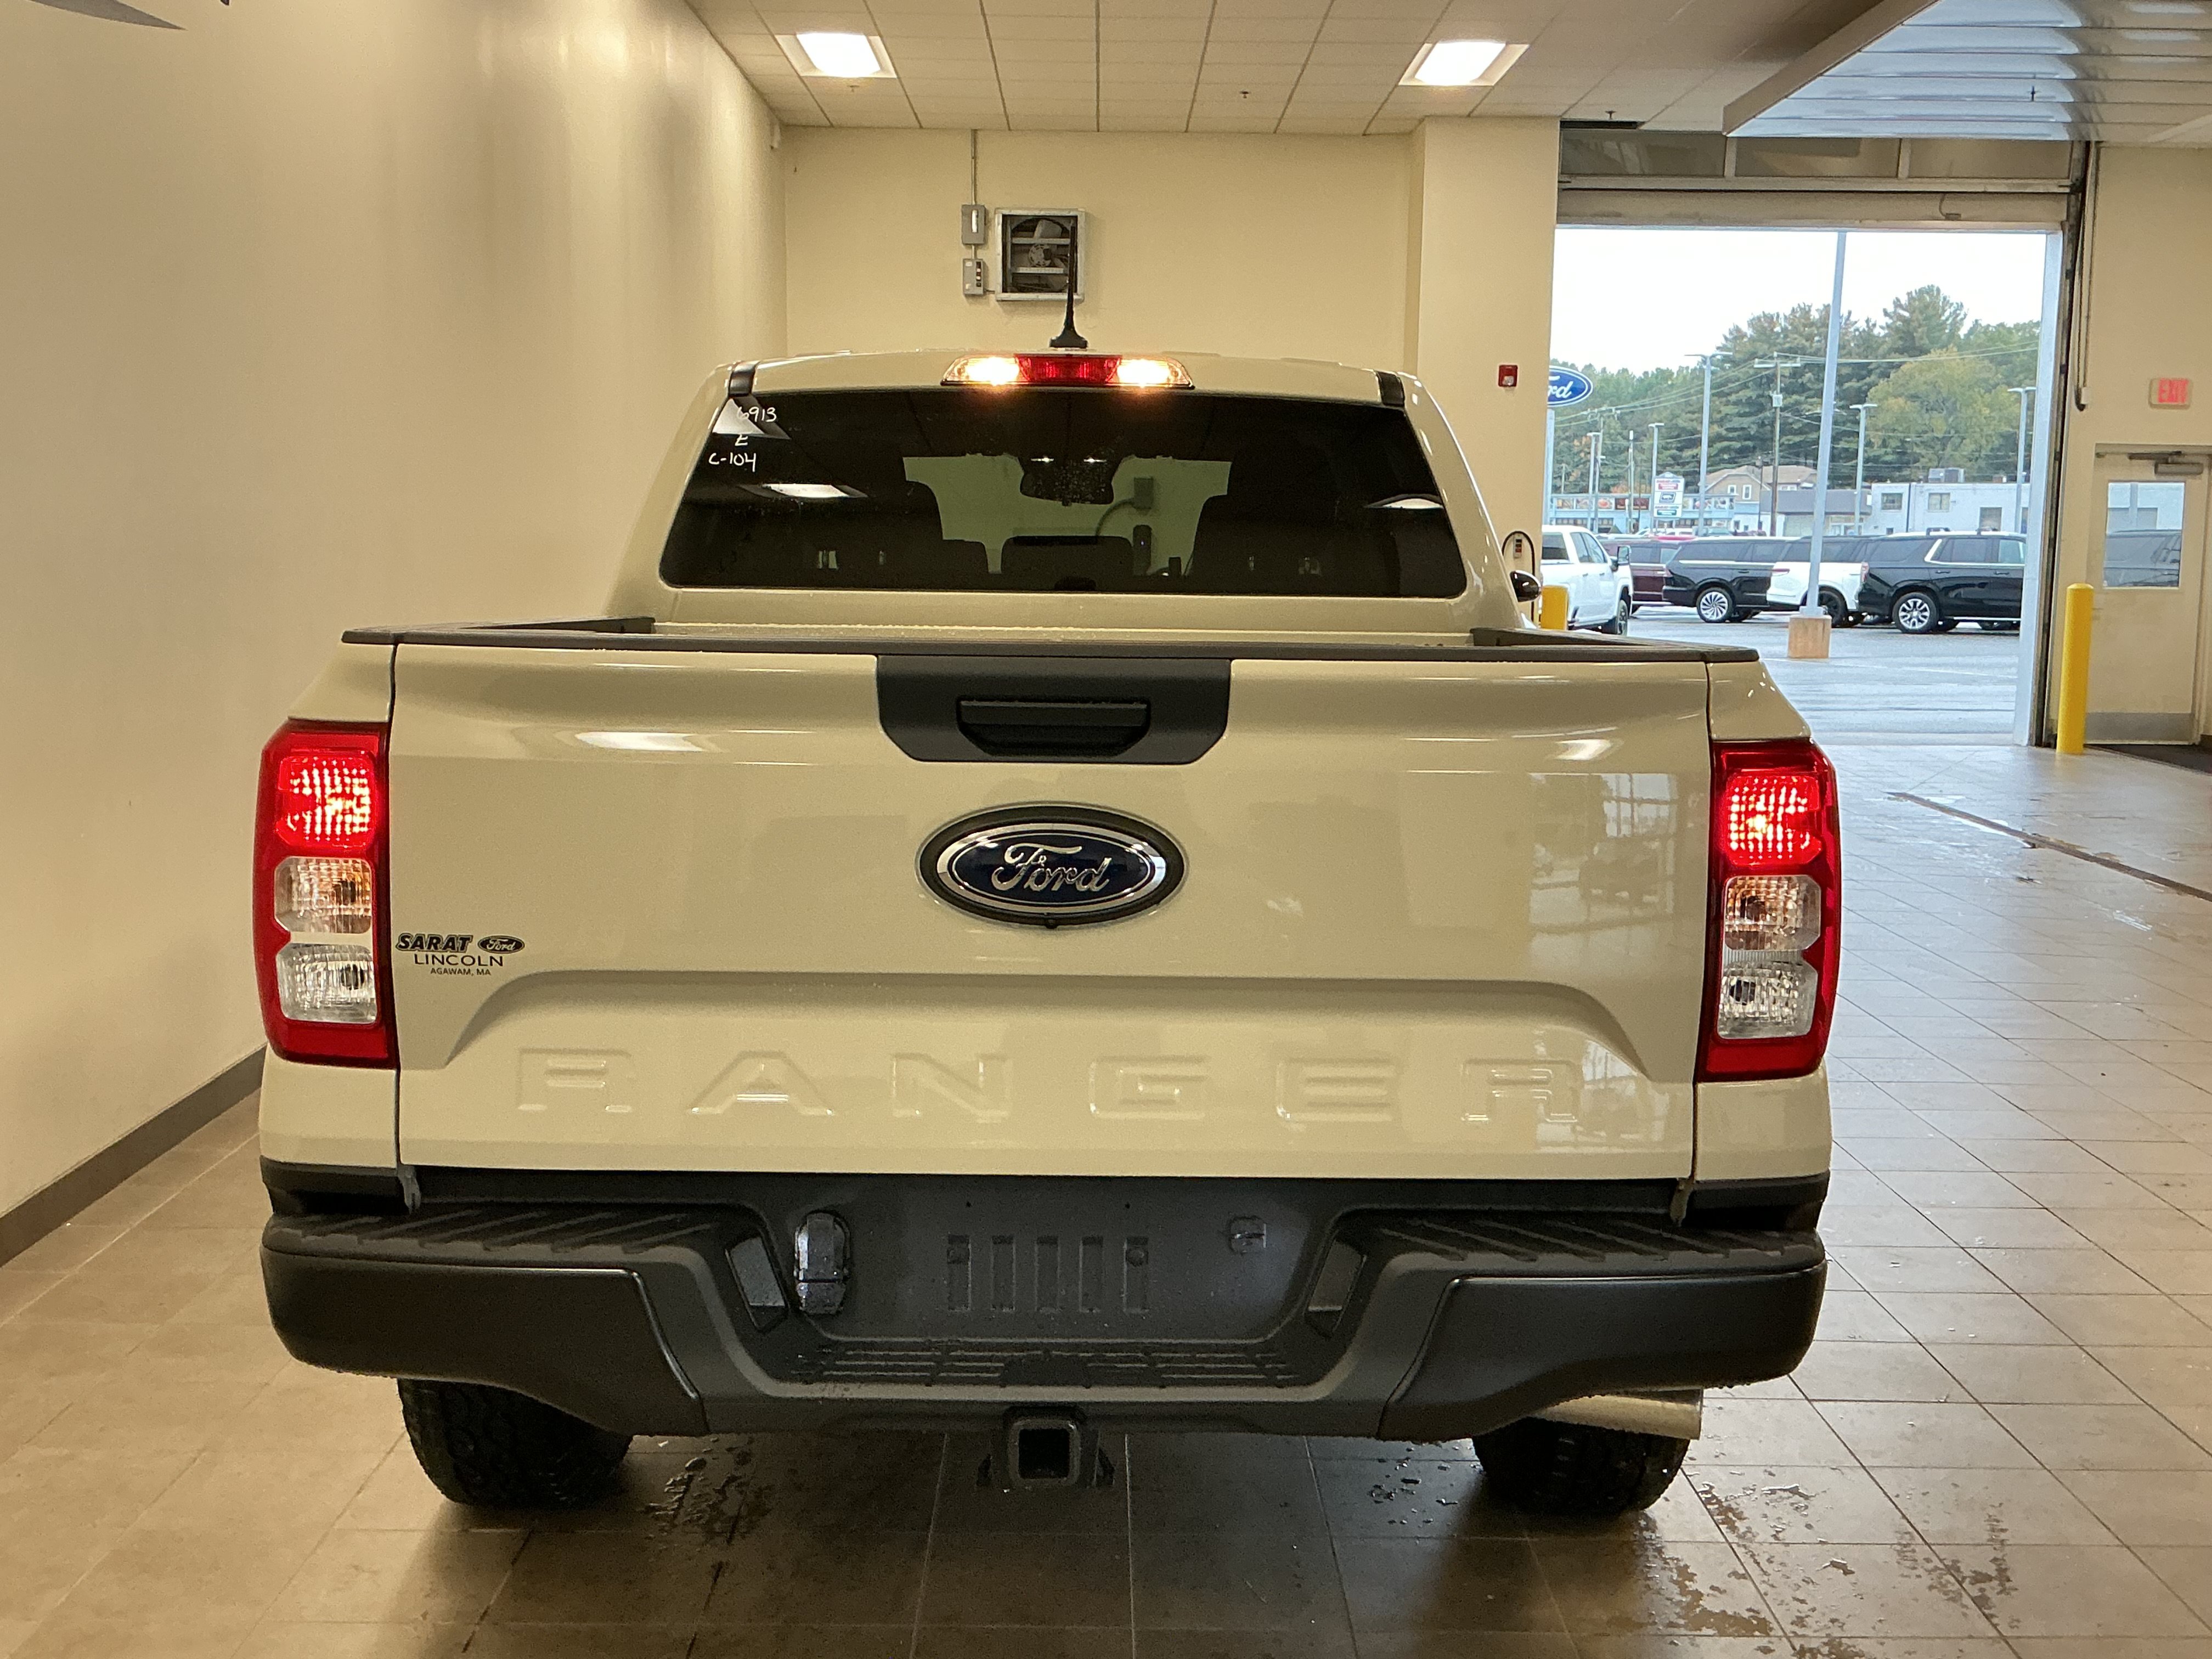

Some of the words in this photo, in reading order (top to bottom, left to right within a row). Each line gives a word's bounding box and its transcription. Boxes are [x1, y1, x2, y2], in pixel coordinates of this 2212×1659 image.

[1547, 375, 1574, 398] rd
[2158, 378, 2189, 403] EXIT
[737, 406, 777, 422] 6913
[708, 452, 757, 472] C-104
[991, 842, 1114, 893] Ford
[396, 933, 473, 953] SARAT
[486, 938, 516, 951] Ford
[414, 953, 503, 967] LINCOLN
[430, 967, 474, 976] AGAWAM,
[476, 968, 491, 976] MA
[517, 1047, 1580, 1122] RANGER
